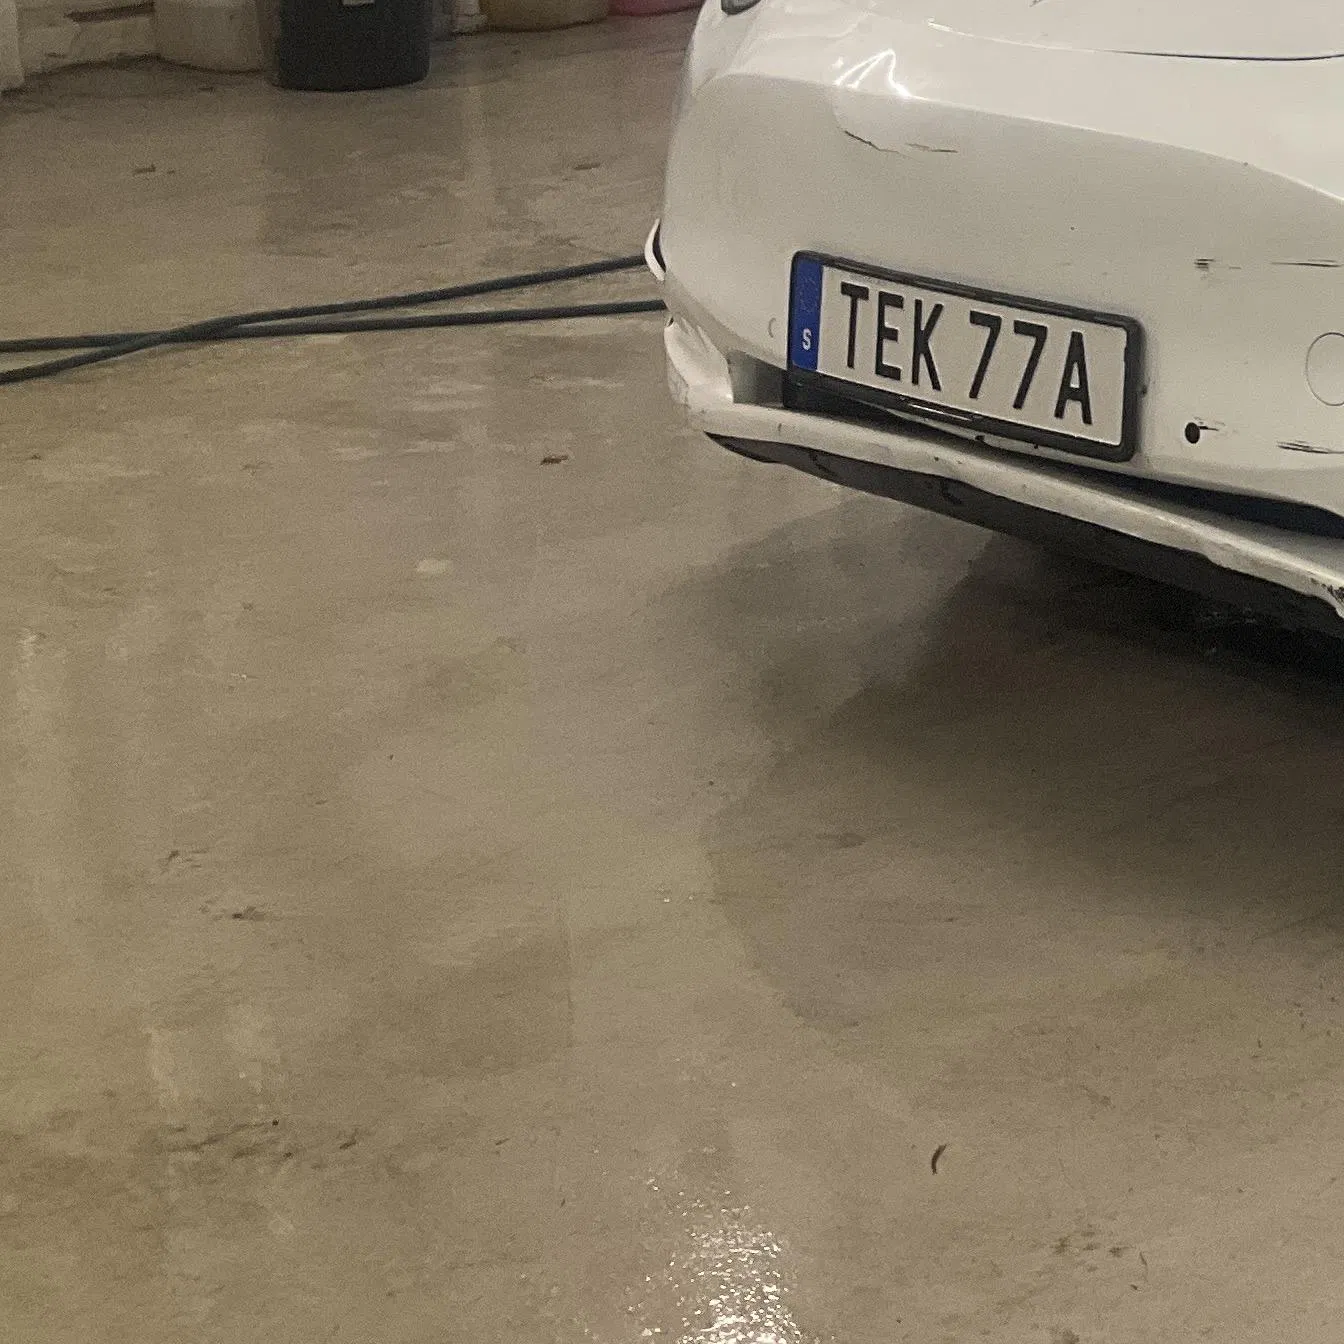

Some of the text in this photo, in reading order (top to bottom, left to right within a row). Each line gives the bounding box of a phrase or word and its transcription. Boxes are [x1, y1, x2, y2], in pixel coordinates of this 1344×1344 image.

[801, 328, 812, 351] S
[840, 281, 1092, 425] TEK 77A
